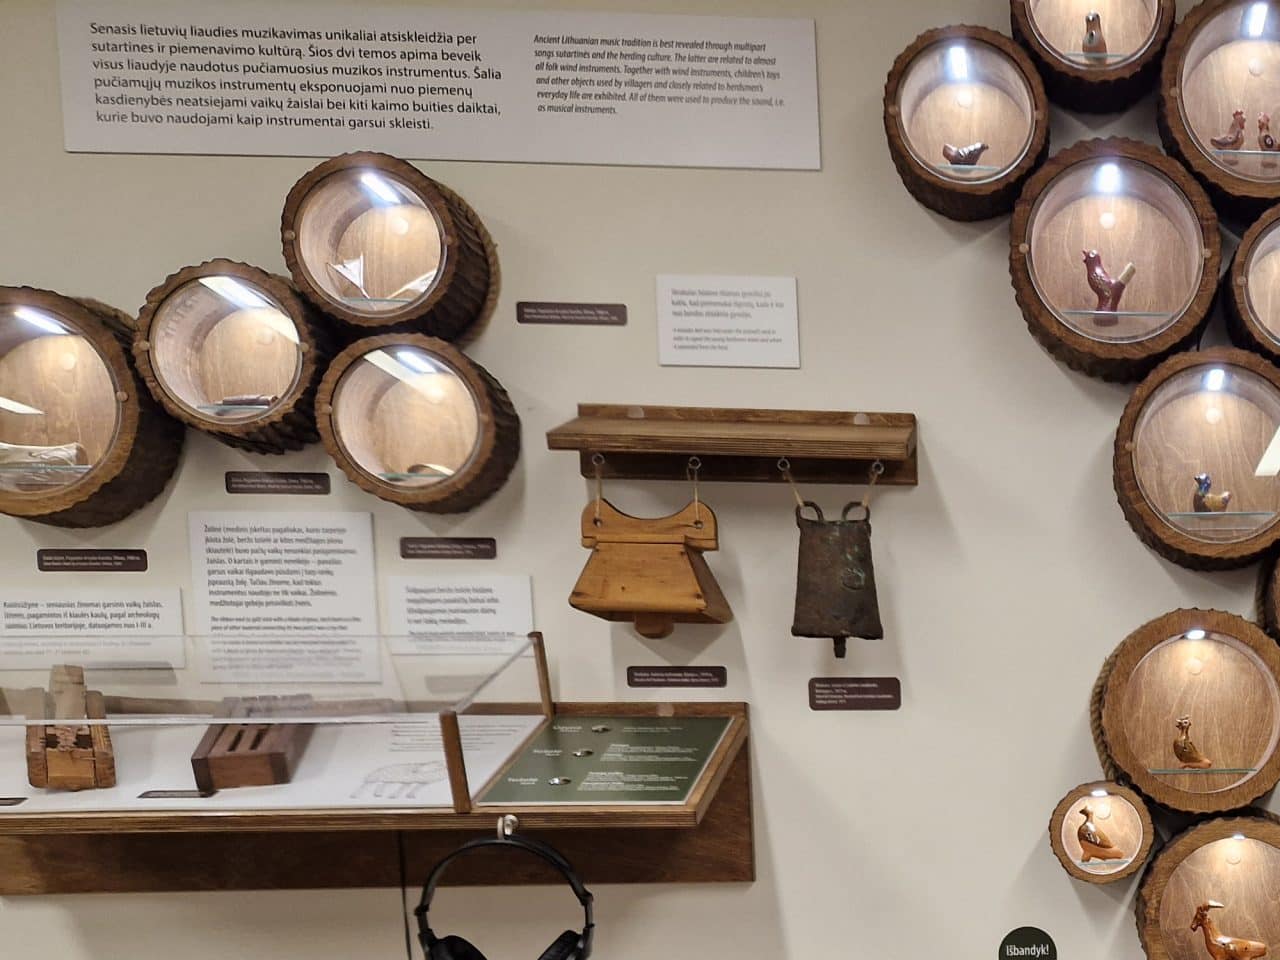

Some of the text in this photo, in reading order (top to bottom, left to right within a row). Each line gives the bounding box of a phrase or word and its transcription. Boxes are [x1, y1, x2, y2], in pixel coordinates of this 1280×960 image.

[90, 22, 477, 47] Senasis lietuvių liaudies muzikavimas unikaliai atsiskleidžia per
[157, 41, 167, 55] ir
[168, 42, 256, 59] piemenavimo
[308, 42, 334, 59] Šios
[336, 46, 356, 59] dvi
[358, 46, 397, 60] temos
[399, 47, 439, 64] apima
[441, 48, 481, 62] beveik
[92, 58, 502, 80] visus liaudyje naudotus pučiamuosius muzikos instrumentus. Šalia
[163, 77, 217, 91] muzikos
[219, 78, 295, 96] instrumentų
[297, 80, 386, 98] eksponuojami
[388, 85, 416, 96] nuo
[418, 83, 473, 100] piemenų
[174, 94, 247, 111] neatsiejami
[248, 96, 283, 112] vaikų
[284, 97, 324, 111] žaislai
[326, 98, 347, 111] bei
[349, 98, 369, 112] kiti
[371, 99, 410, 112] kaimo
[412, 99, 453, 113] buities
[455, 100, 501, 117] daiktai,
[97, 110, 128, 124] kurie
[130, 111, 164, 125] buvo
[166, 112, 234, 129] naudojami
[236, 113, 264, 129] kaip
[266, 114, 344, 128] instrumentai
[346, 115, 385, 132] garsui
[1006, 944, 1049, 958] Išbandyk!
